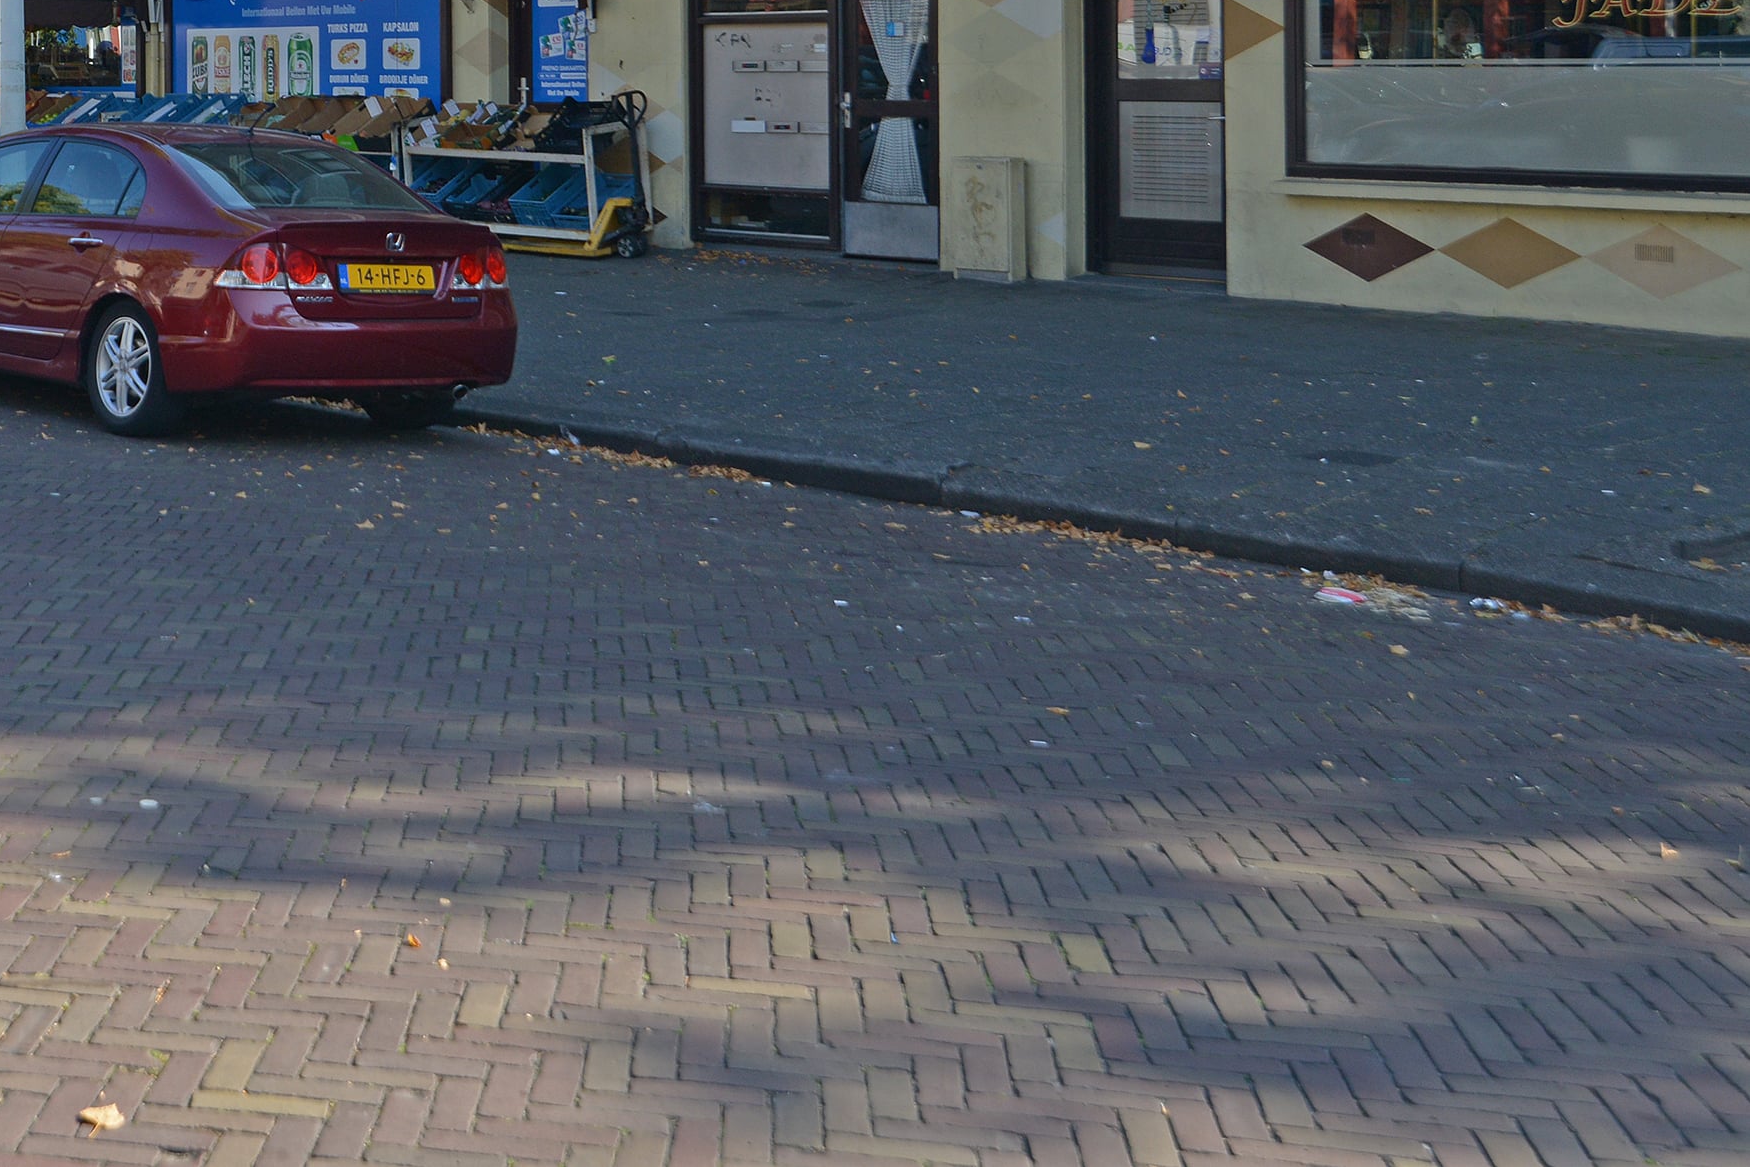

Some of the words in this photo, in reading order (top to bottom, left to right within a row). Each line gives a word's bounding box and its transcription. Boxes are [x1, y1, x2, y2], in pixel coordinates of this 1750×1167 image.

[242, 7, 284, 17] Internationaal
[307, 5, 320, 15] Met
[333, 4, 356, 14] Mobile
[327, 23, 348, 34] TURKS
[349, 22, 368, 33] PIZZA
[382, 21, 419, 32] KAPSALON
[379, 75, 407, 84] BROODJE
[357, 267, 426, 286] 14-HFJ-6
